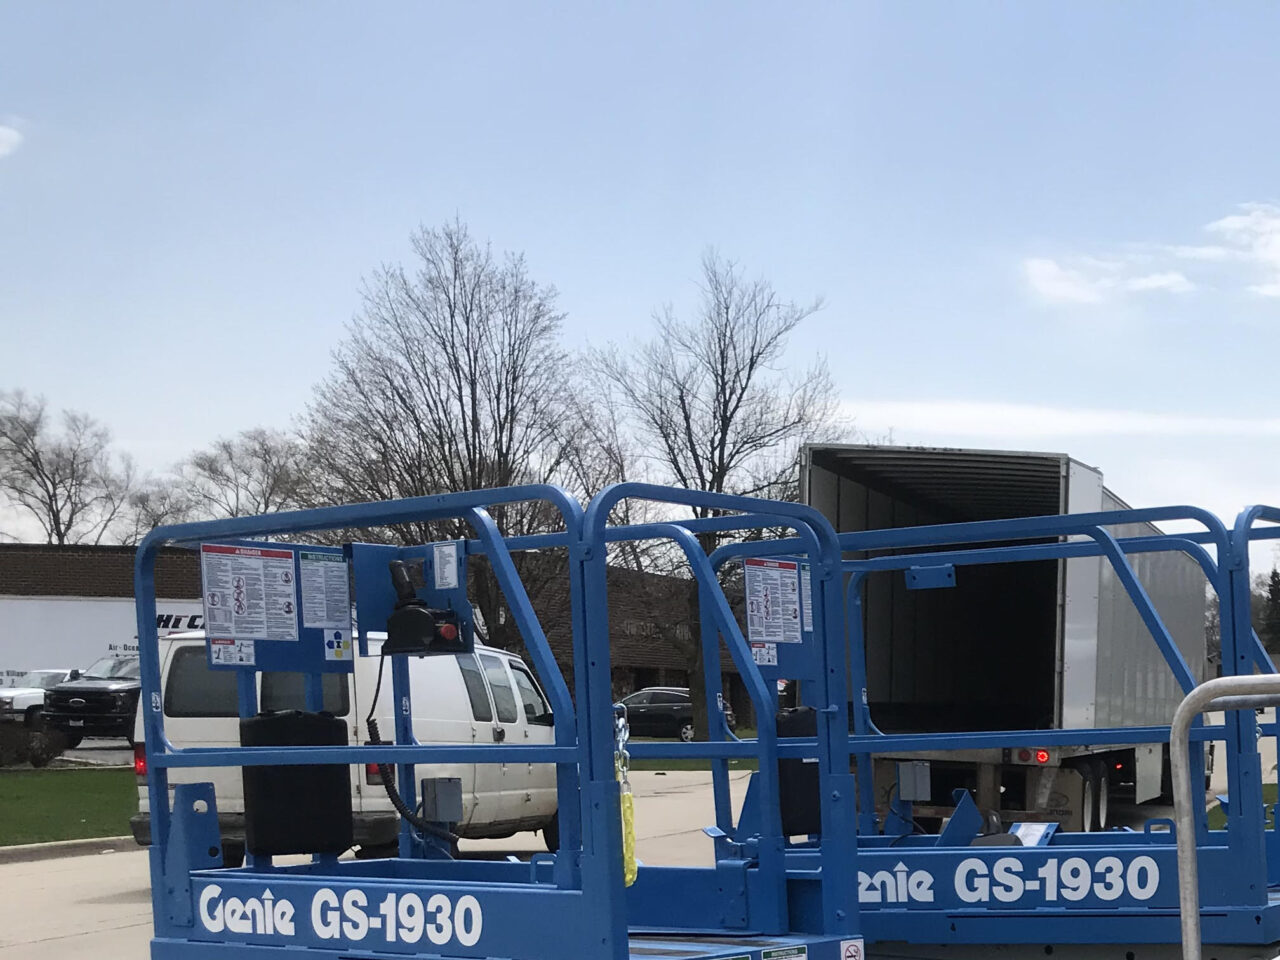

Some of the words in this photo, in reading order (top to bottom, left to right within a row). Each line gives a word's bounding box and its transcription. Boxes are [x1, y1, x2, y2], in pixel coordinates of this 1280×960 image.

[858, 861, 934, 903] enie
[954, 855, 1160, 903] GS-1930
[200, 884, 296, 936] Genie
[311, 888, 483, 947] GS-1930
